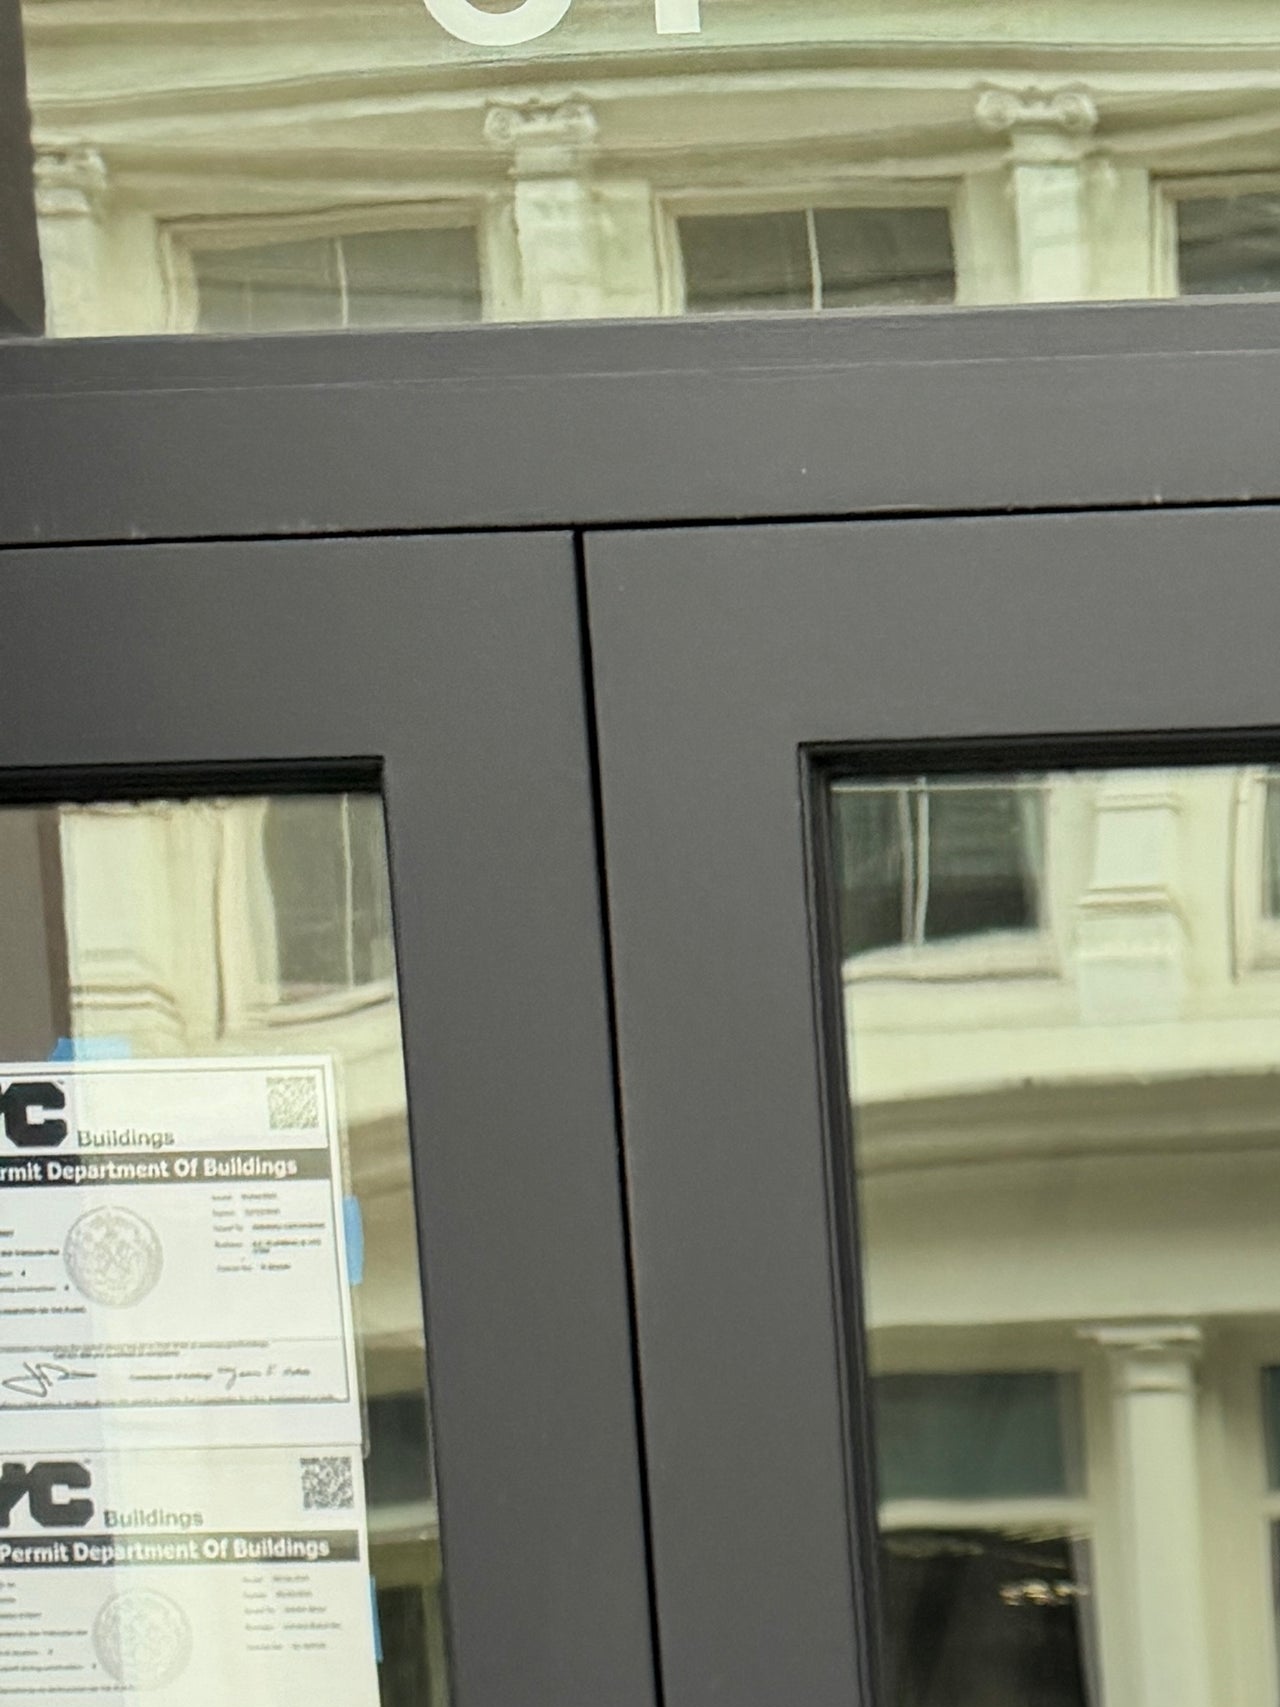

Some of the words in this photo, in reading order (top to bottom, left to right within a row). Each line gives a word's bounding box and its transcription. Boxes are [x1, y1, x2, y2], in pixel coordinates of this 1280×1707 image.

[77, 1130, 175, 1148] Buildings
[48, 1160, 169, 1183] Department
[174, 1158, 199, 1177] Of
[204, 1156, 298, 1178] Buildings
[104, 1510, 204, 1529] Buildings
[0, 1543, 70, 1563] Permit
[74, 1540, 200, 1563] Department
[203, 1538, 229, 1558] Of
[235, 1536, 330, 1558] Buildings
